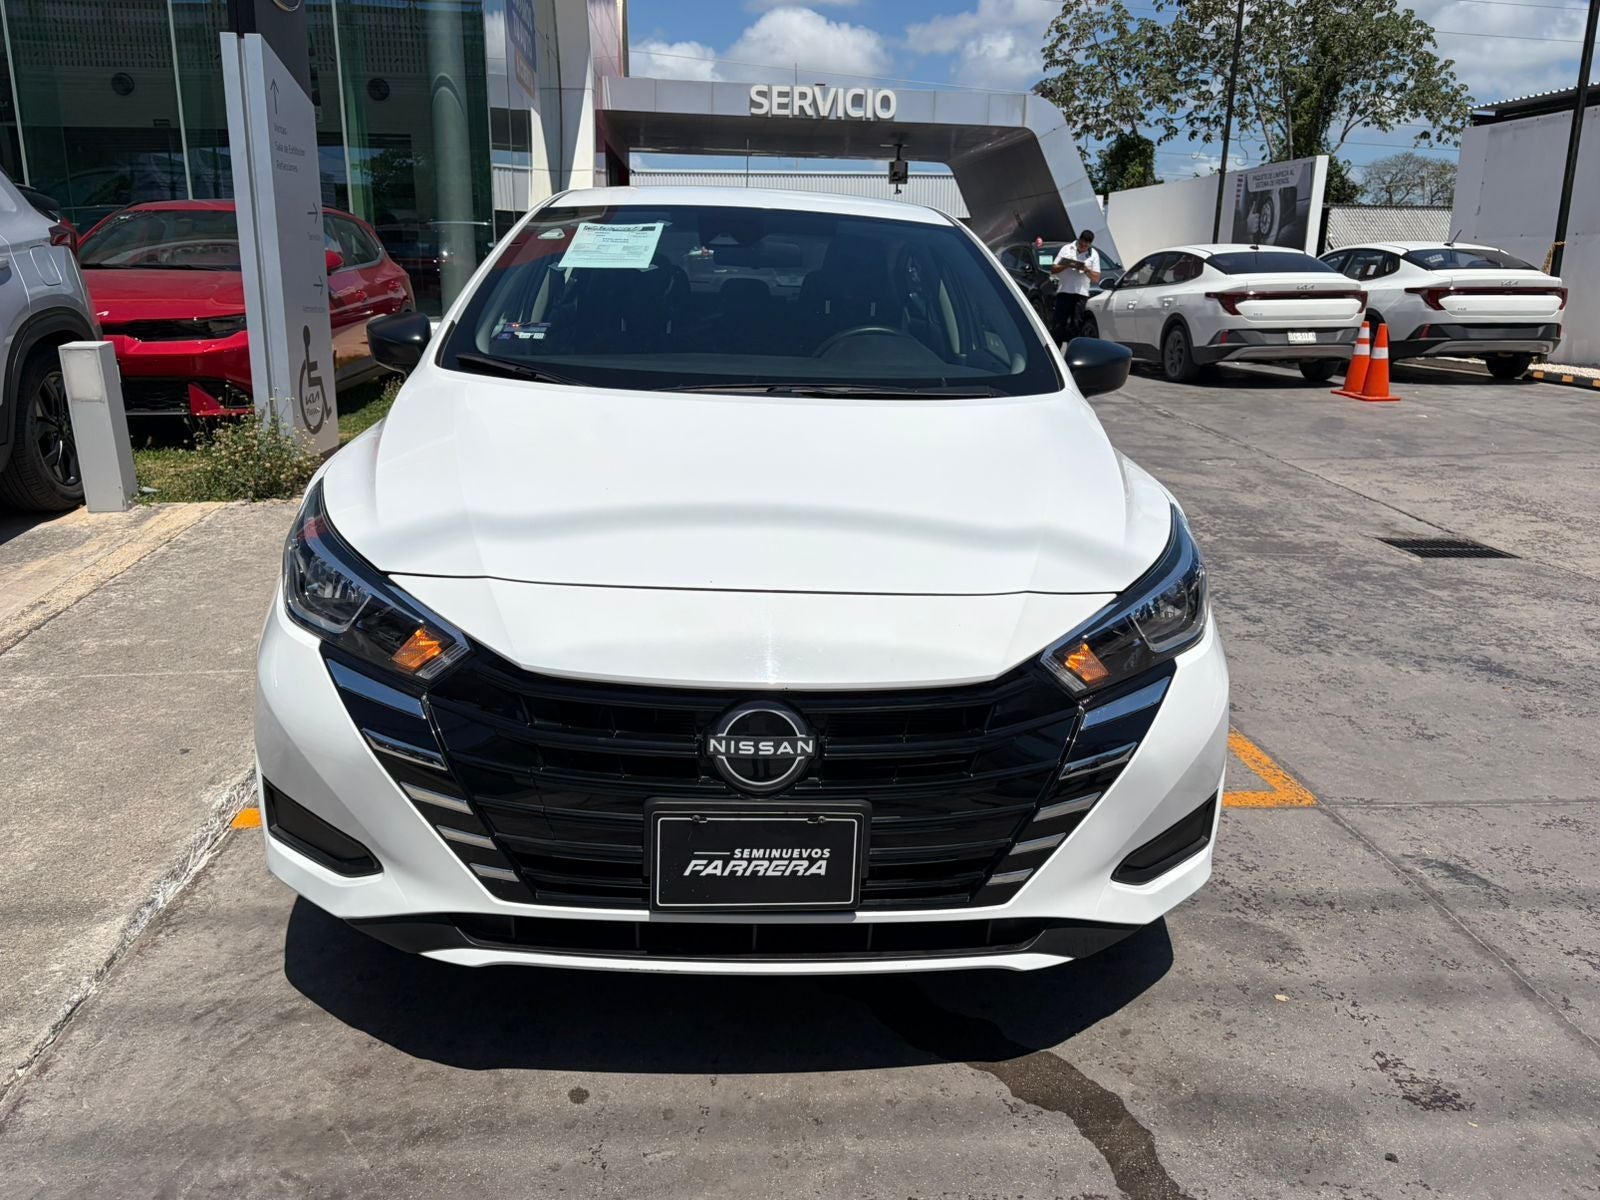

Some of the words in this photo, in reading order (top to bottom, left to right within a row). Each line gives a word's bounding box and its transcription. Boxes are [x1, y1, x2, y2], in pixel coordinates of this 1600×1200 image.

[750, 84, 897, 120] SERVICIO
[709, 738, 813, 755] NISSAN
[733, 848, 831, 858] SEMINUEVOS
[683, 859, 828, 876] FARRERA
